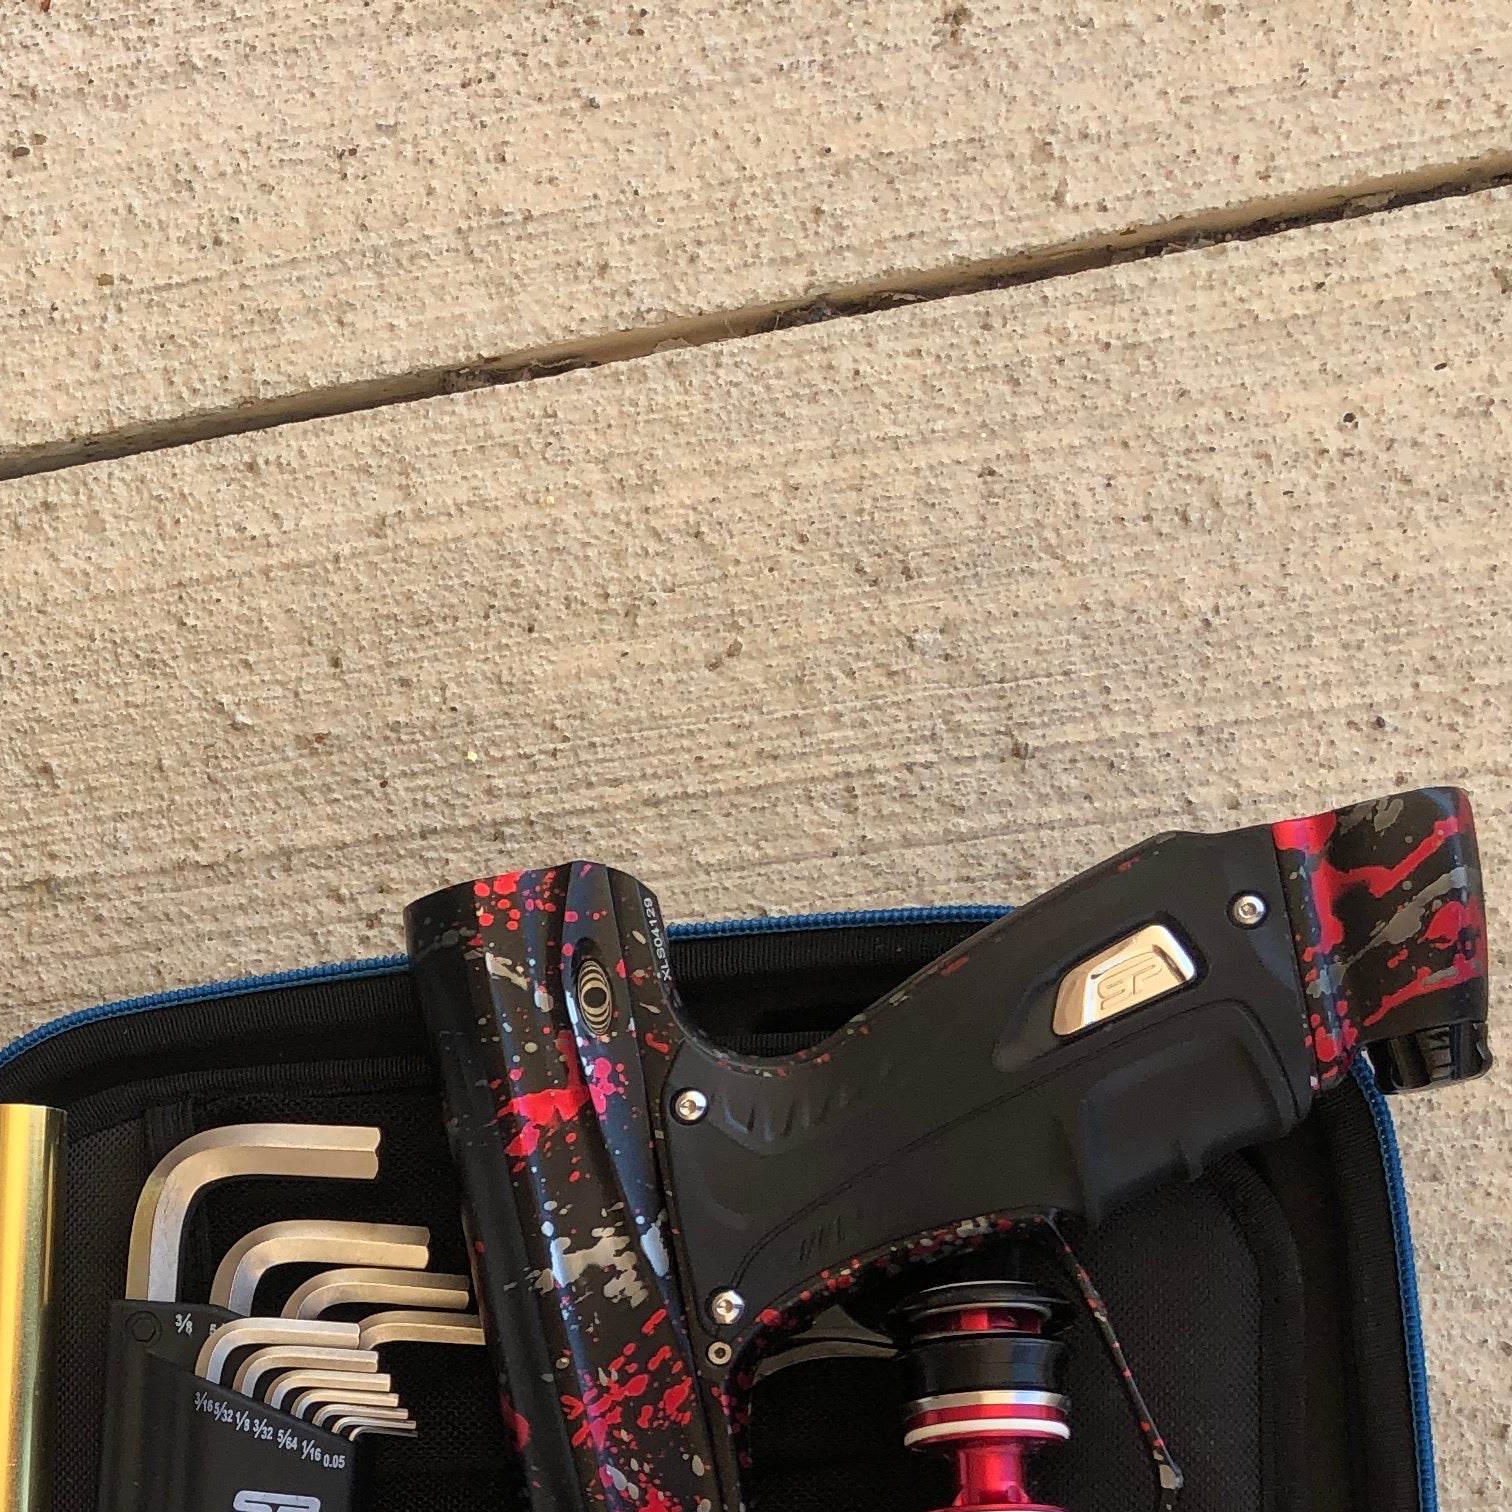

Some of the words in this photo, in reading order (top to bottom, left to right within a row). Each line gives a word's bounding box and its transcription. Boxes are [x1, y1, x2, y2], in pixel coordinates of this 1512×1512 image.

[644, 898, 672, 981] XLS04129
[175, 1313, 193, 1334] 3/8
[194, 1392, 214, 1411] 3/16
[214, 1401, 233, 1423] 5/32
[235, 1411, 250, 1431] 1/8
[252, 1418, 273, 1440] 3/32
[277, 1429, 298, 1450] 5/64
[302, 1440, 321, 1460] 1/16
[322, 1455, 346, 1469] 0.05
